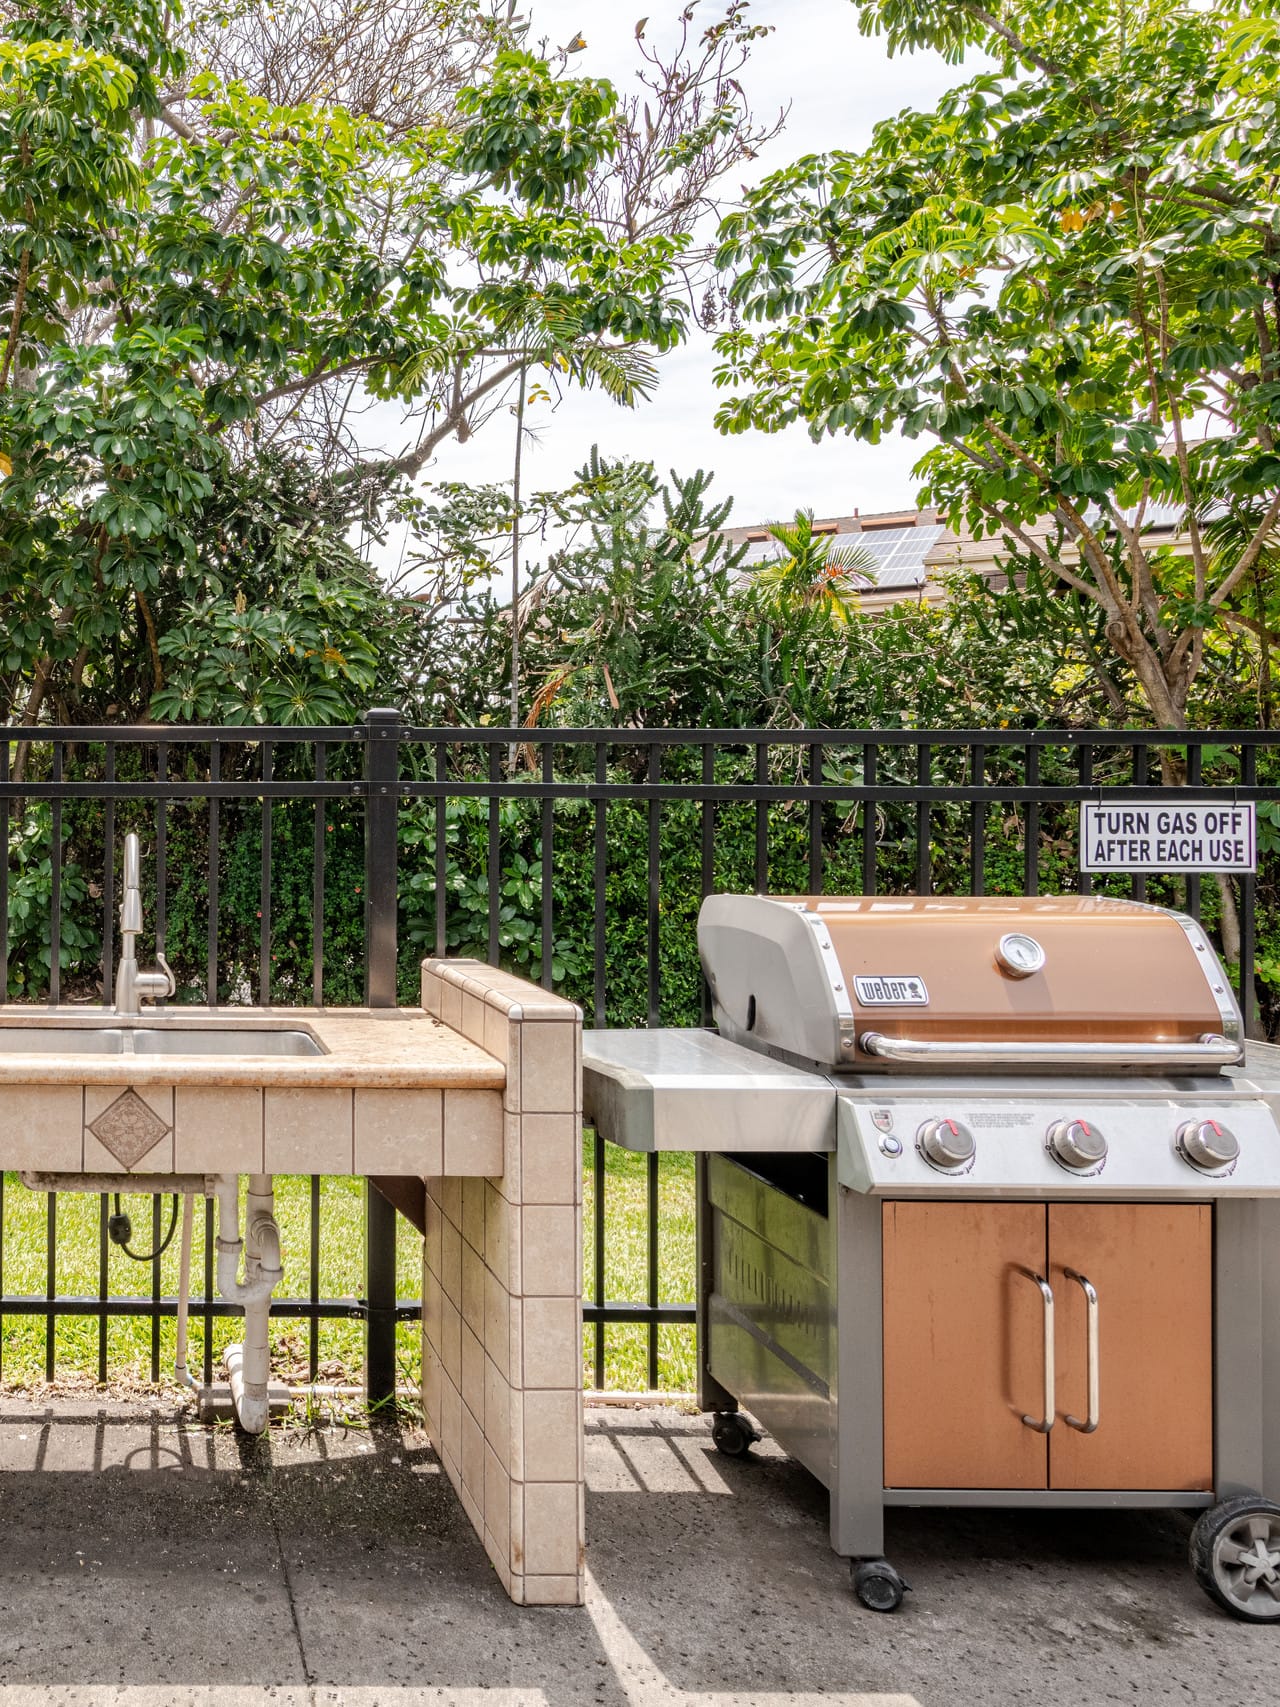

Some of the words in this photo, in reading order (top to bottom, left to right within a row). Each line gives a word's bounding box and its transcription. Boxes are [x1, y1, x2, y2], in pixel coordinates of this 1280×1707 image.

[1094, 812, 1149, 835] TURN
[1157, 812, 1197, 835] GAS
[1204, 812, 1242, 835] OFF
[1094, 839, 1151, 862] AFTER
[1157, 839, 1203, 862] EACH
[1210, 839, 1244, 863] USE
[861, 977, 907, 1000] weber
